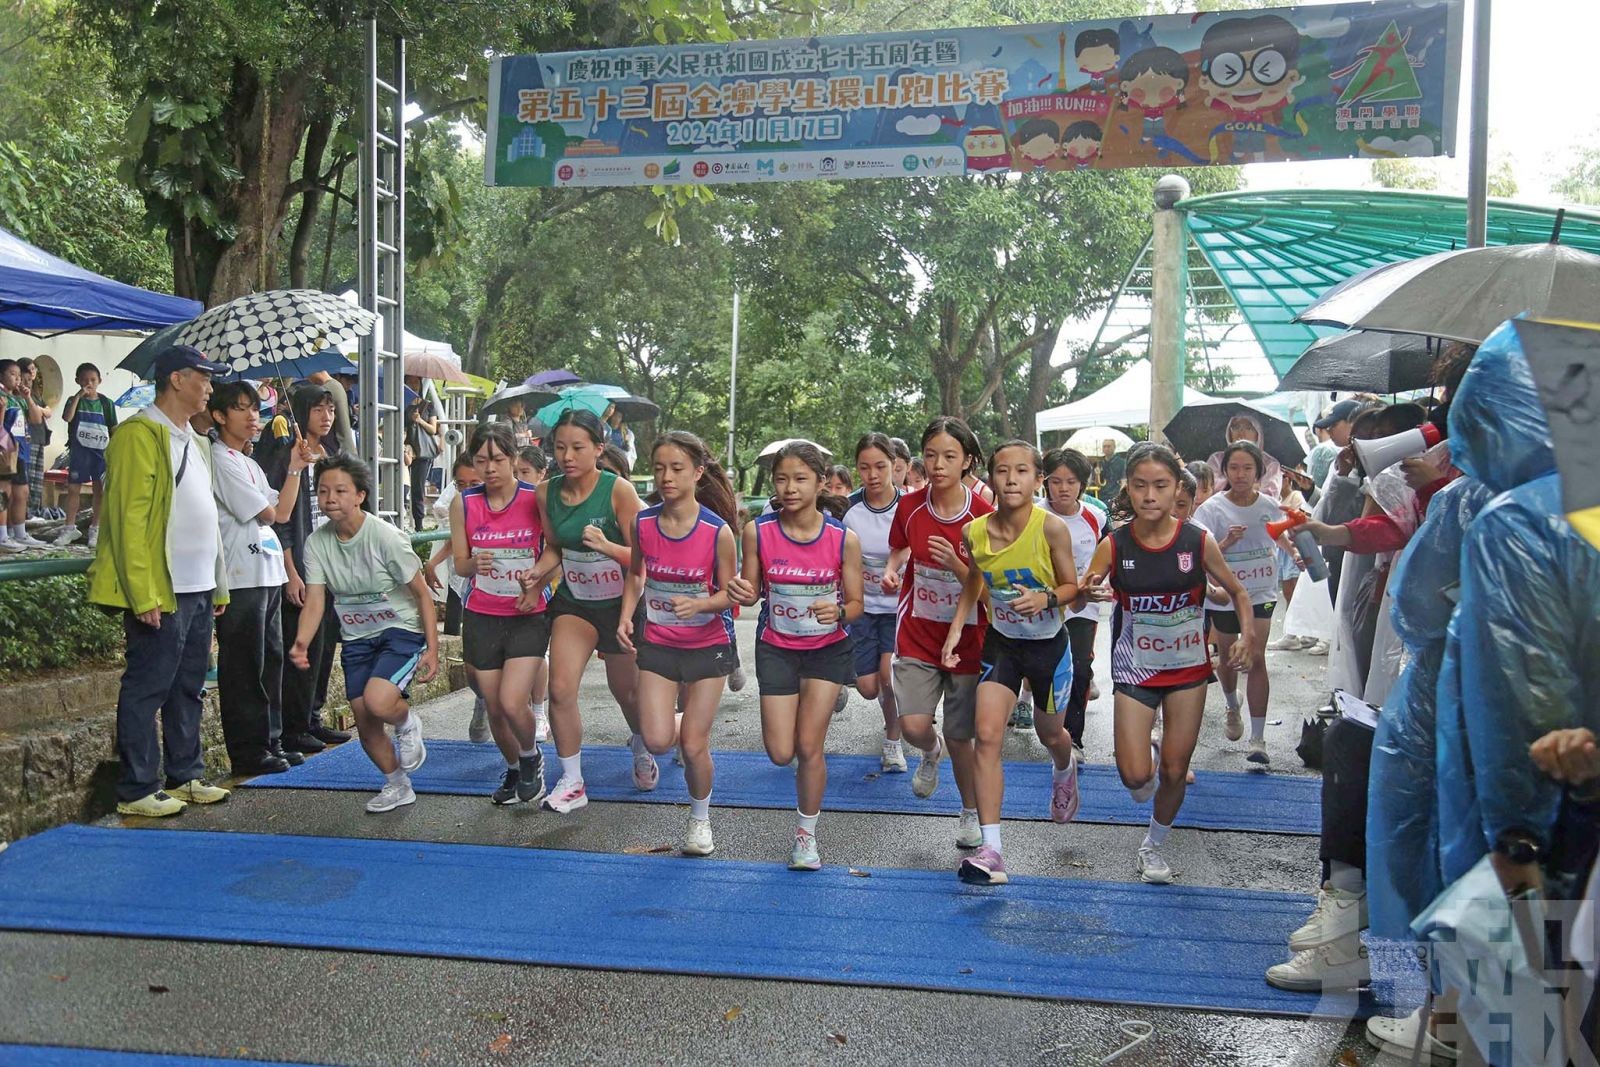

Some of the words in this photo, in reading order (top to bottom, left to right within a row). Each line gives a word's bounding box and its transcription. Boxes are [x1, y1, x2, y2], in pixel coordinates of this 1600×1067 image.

[568, 39, 960, 82] 慶祝中華人民共和國成立七十五周年暨
[1056, 97, 1096, 112] RUN!!!
[667, 115, 842, 144] 2024年11月17日
[1224, 122, 1266, 132] GOAL
[471, 529, 534, 541] ATHLETE
[489, 567, 530, 582] C-10
[567, 569, 621, 585] GC-116
[767, 566, 836, 577] ATHLETE
[1232, 567, 1273, 581] C-113
[342, 610, 396, 625] GC-118
[772, 604, 814, 620] GC-1
[1136, 631, 1201, 652] GC-114
